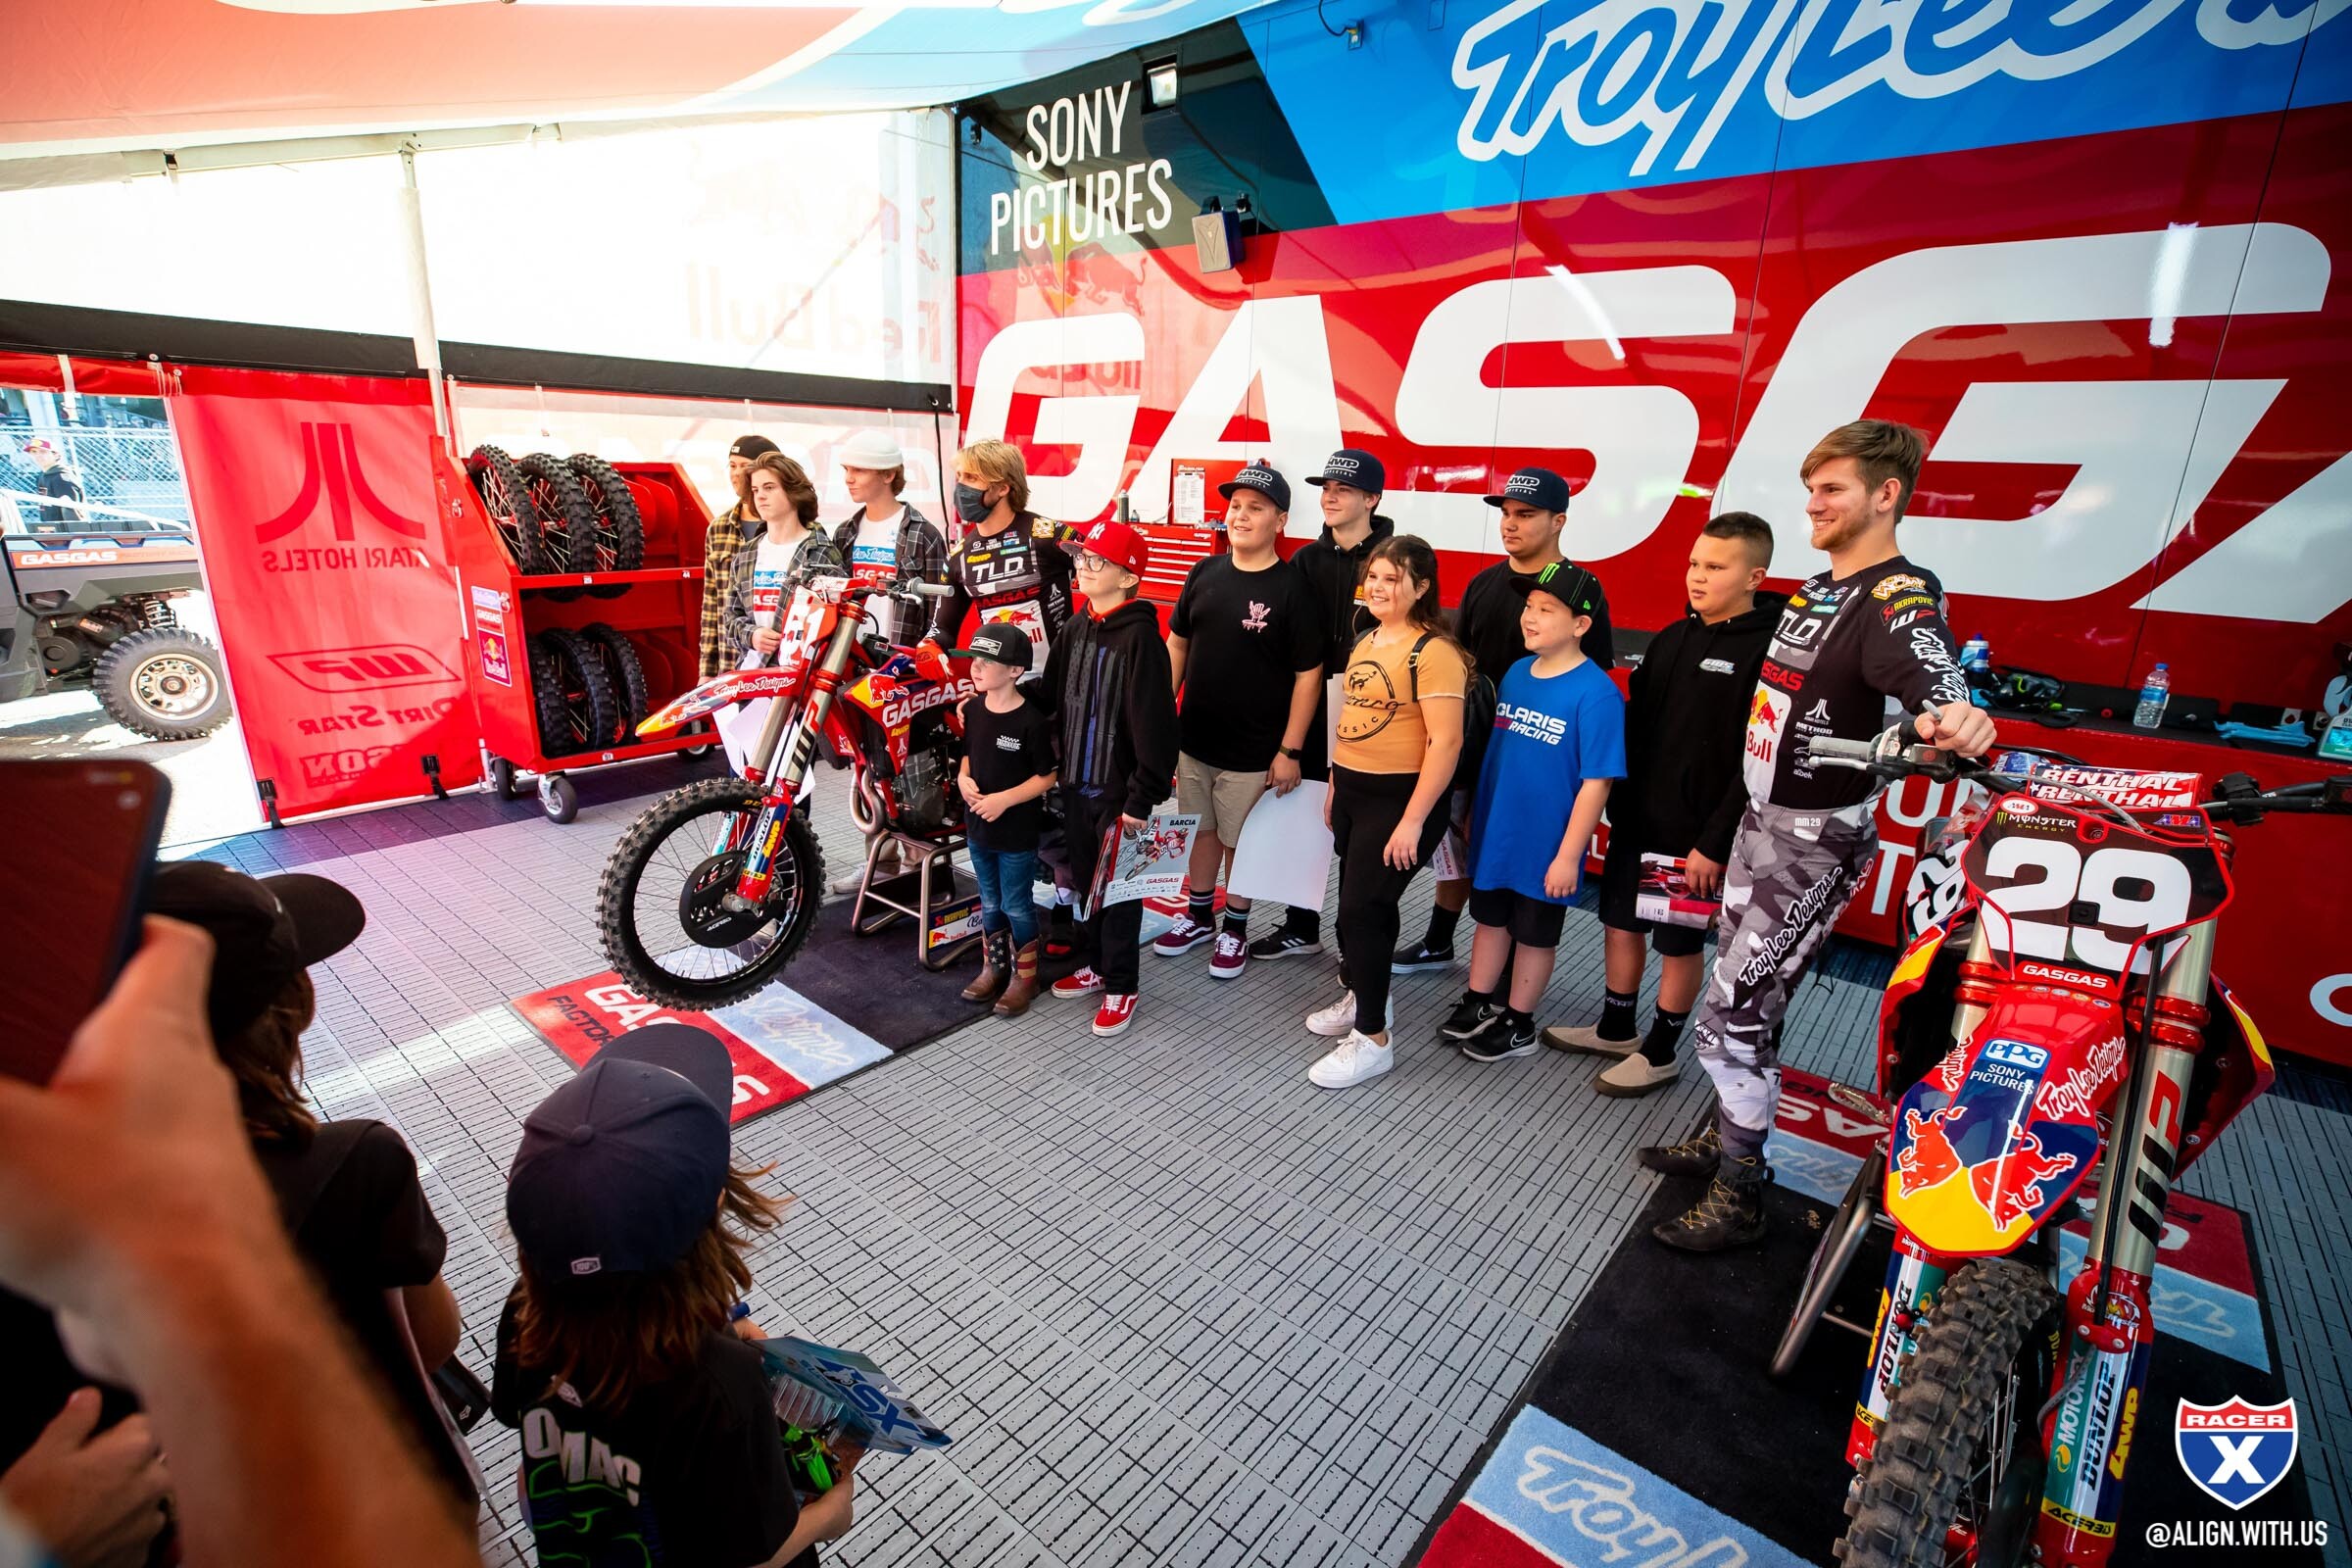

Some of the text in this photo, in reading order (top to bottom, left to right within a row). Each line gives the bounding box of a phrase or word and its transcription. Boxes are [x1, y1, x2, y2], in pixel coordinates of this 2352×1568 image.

[1026, 80, 1132, 171] SONY
[990, 159, 1173, 255] PICTURES
[957, 222, 2352, 624] GASG
[21, 551, 118, 565] GASGAS
[854, 568, 897, 580] SGAS
[971, 557, 1025, 583] TLD
[779, 604, 825, 665] 51
[1775, 609, 1823, 646] TLD
[738, 680, 758, 692] Lee
[756, 675, 796, 692] Designs
[1761, 661, 1805, 691] SGAS
[883, 678, 976, 728] GASGAS
[1495, 702, 1568, 735] OLARIS
[1508, 720, 1563, 746] RACING
[1746, 730, 1772, 763] Bull
[2035, 783, 2180, 808] RENTHAL
[2040, 767, 2184, 792] RENTHAL
[753, 811, 772, 861] DUNLOP
[2017, 823, 2066, 833] ENERGY
[1982, 836, 2192, 976] 29
[1739, 866, 1842, 986] Troy Lee Designs
[2022, 964, 2108, 989] GASGAS
[1988, 1043, 2046, 1065] PPG
[1970, 1069, 2035, 1096] PICTURES
[1986, 1062, 2027, 1079] SONY
[2034, 1080, 2090, 1121] Troy
[2082, 1359, 2116, 1492] DUNLOP
[520, 1406, 641, 1507] OMAC
[2048, 1506, 2112, 1537] ACERBI
